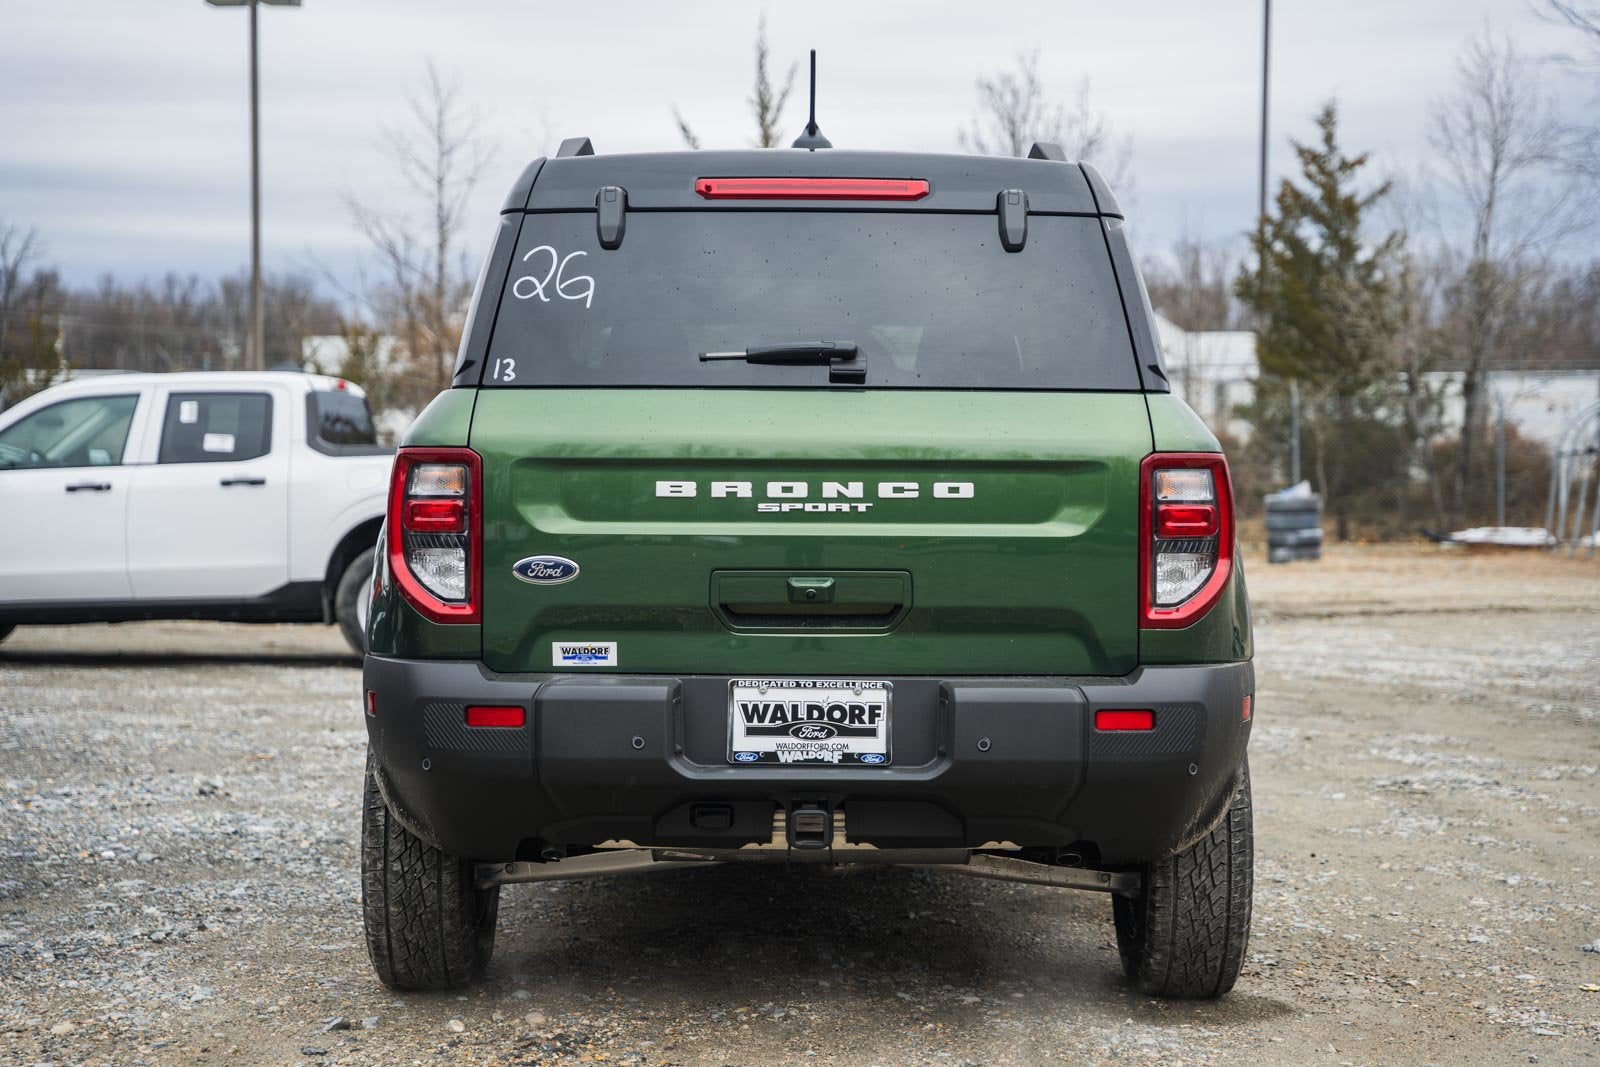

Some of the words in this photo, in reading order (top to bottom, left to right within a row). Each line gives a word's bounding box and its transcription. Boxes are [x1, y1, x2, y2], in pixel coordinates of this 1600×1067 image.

[493, 358, 516, 382] 13
[655, 480, 975, 499] BRONCO
[757, 502, 874, 512] SPORT
[527, 560, 564, 577] Ford
[561, 646, 610, 656] WALDORF
[738, 680, 796, 688] DEDICATED
[816, 681, 883, 689] EXCELLENCE
[739, 703, 882, 725] WALDORF
[798, 725, 828, 740] Ford
[775, 743, 849, 751] WALDORFFORD.COM
[776, 750, 844, 764] WALDORF
